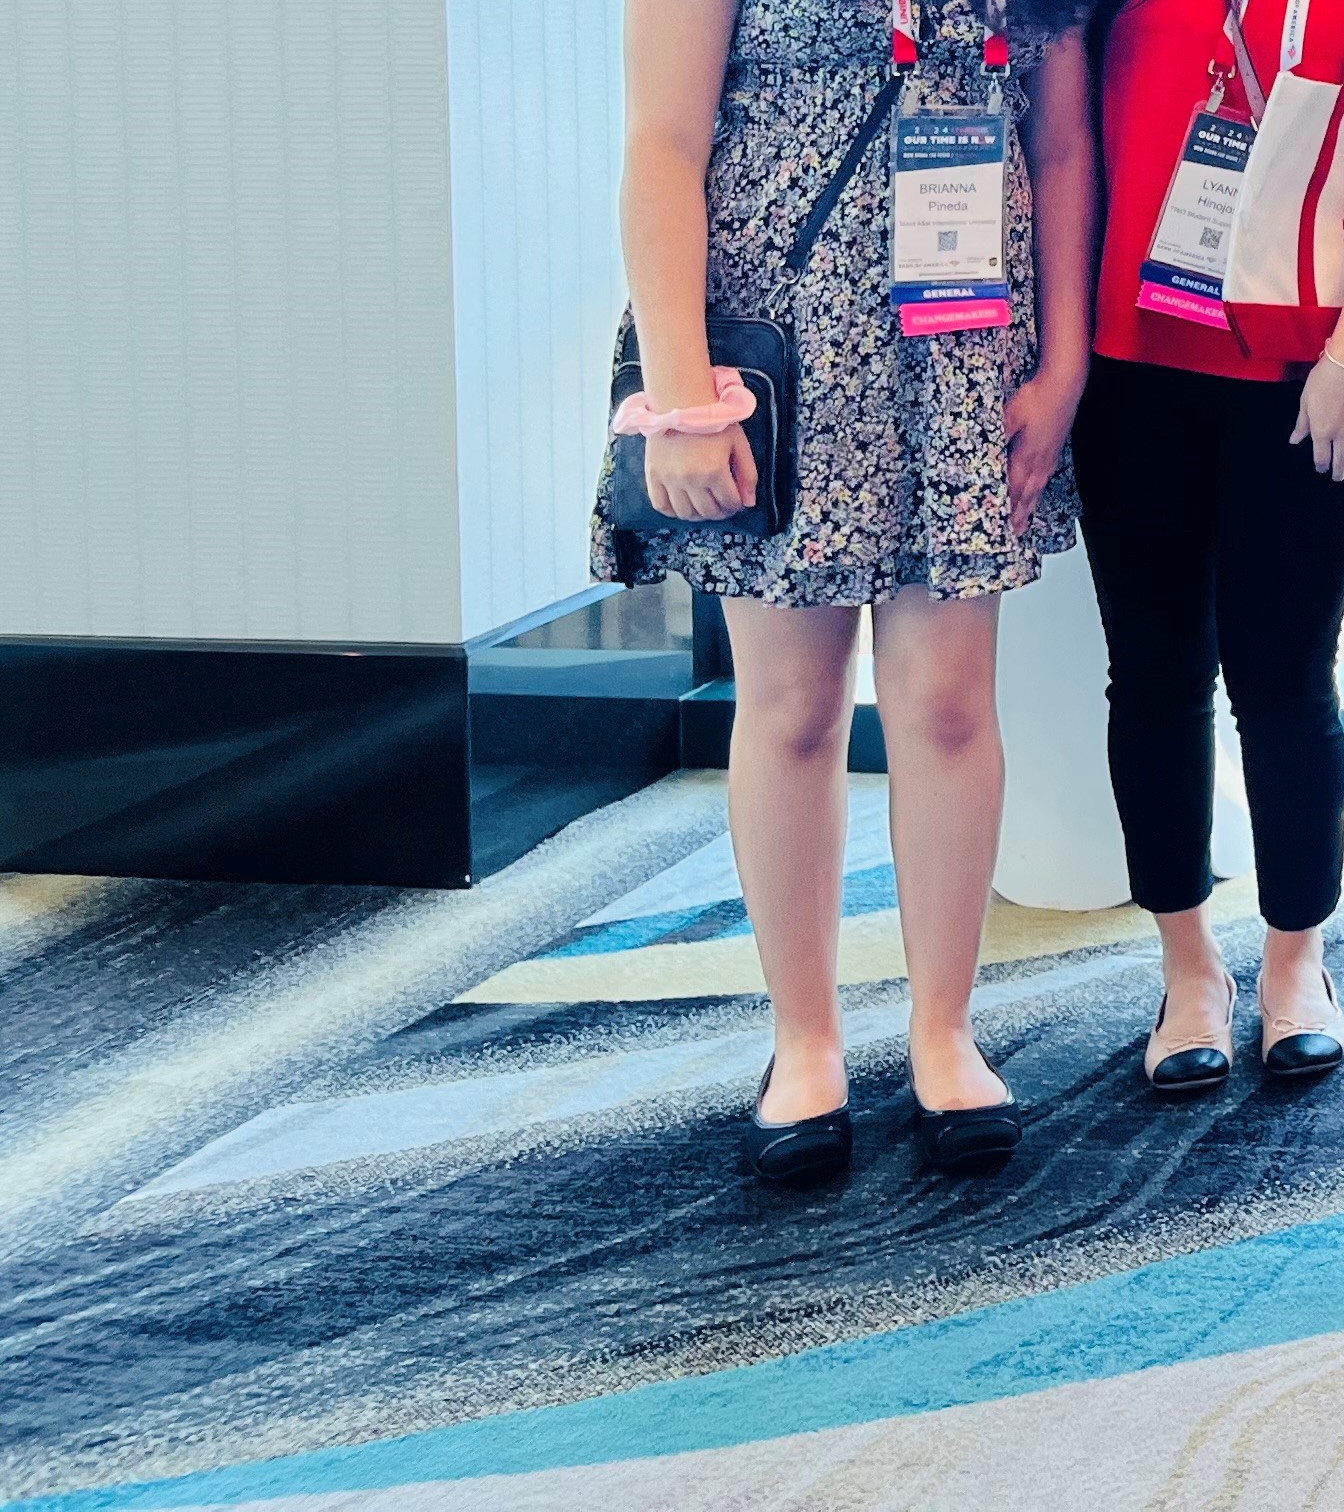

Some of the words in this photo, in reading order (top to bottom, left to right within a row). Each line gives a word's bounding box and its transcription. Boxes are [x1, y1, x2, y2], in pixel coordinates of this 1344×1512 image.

[1198, 130, 1221, 144] OUR
[1222, 136, 1248, 152] TIME
[919, 183, 977, 195] BRIANNA
[928, 201, 968, 212] Pineda
[922, 288, 976, 299] GENERAL
[1171, 275, 1221, 296] GENERAL
[1150, 292, 1225, 319] CHANGEMAKER
[912, 309, 998, 326] CHANGEMAKERS
